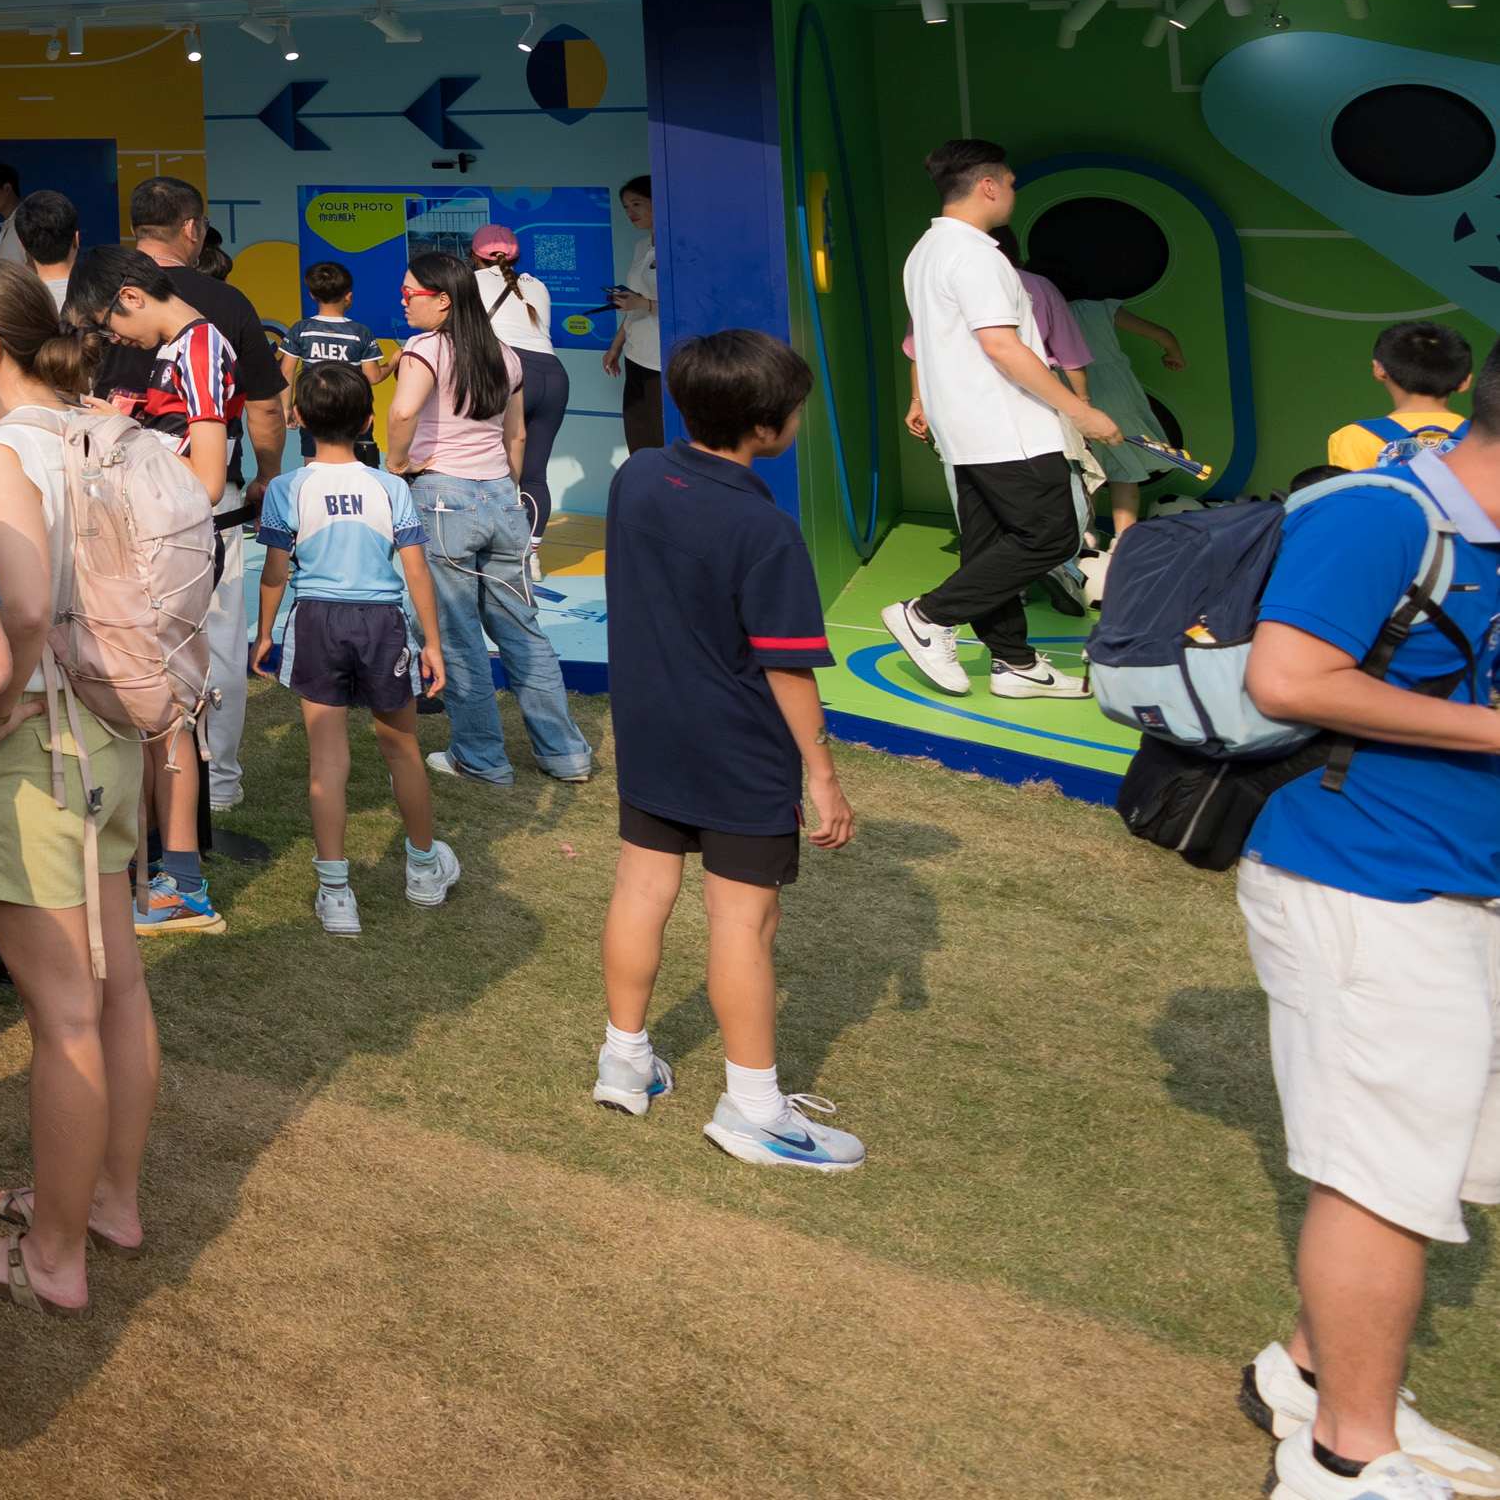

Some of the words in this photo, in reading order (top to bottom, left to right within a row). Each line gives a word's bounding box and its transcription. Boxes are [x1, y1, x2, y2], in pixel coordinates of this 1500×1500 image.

[318, 202, 350, 211] YOUR
[353, 202, 394, 212] PHOTO
[310, 342, 349, 361] ALEX
[324, 493, 363, 516] BEN
